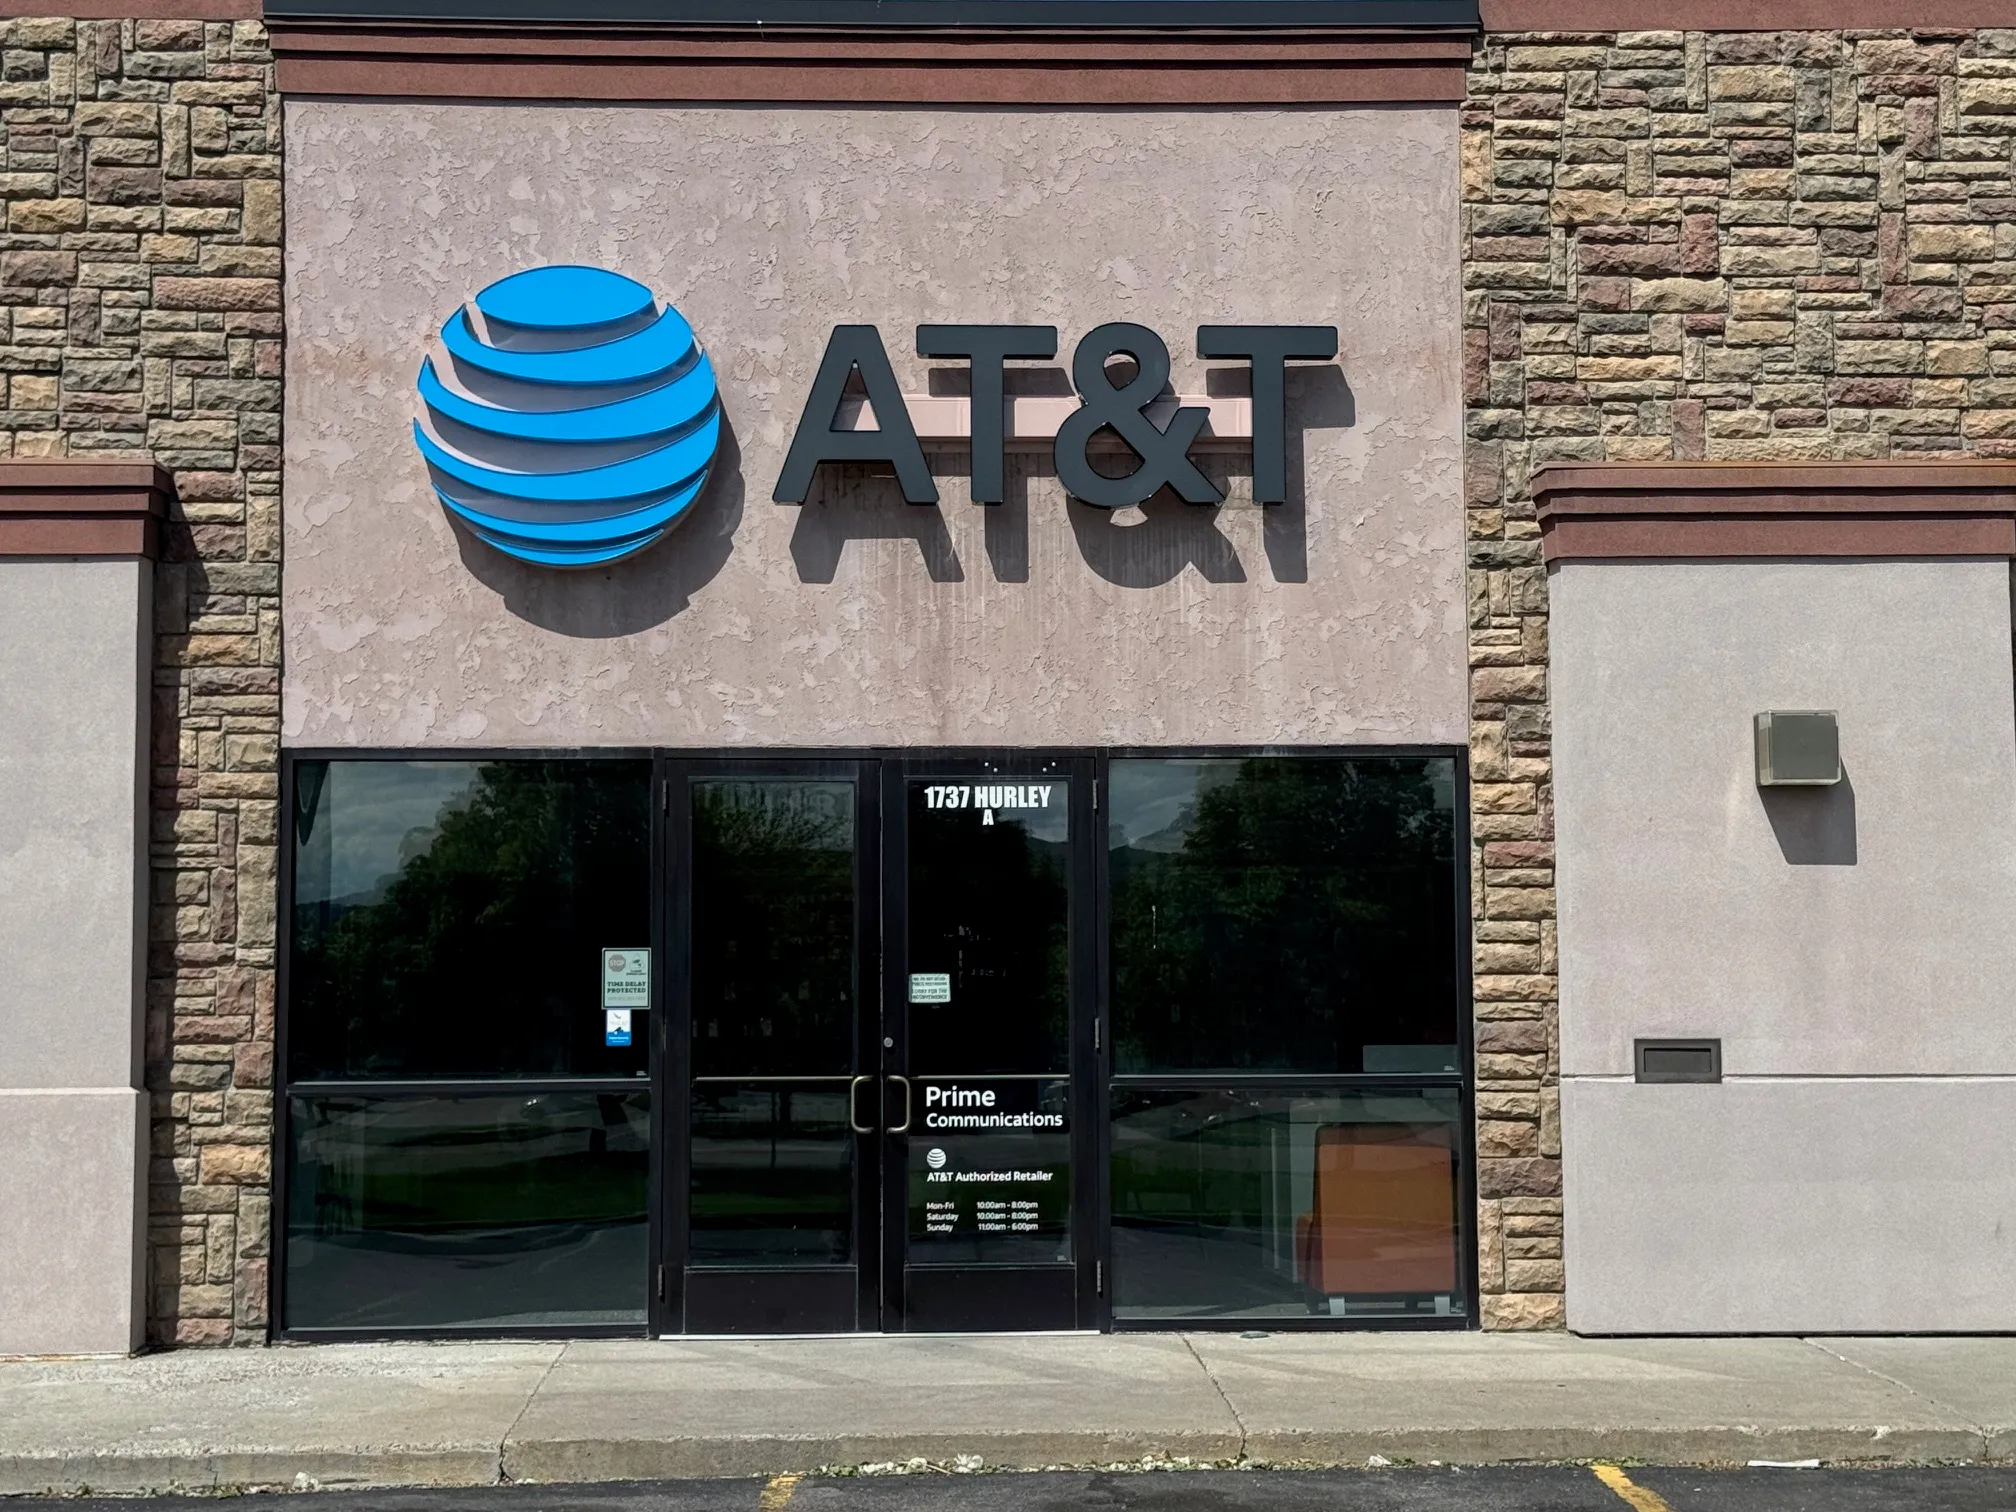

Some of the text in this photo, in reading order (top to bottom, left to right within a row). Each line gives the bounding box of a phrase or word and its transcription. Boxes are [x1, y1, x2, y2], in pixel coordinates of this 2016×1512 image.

[772, 322, 1339, 507] AT&T
[923, 785, 1052, 809] 1737 HURLEY
[982, 808, 995, 826] A
[926, 1085, 996, 1107] Prime
[926, 1111, 1063, 1128] Communications
[926, 1171, 1053, 1182] AT&T Authorized Retailer
[926, 1201, 955, 1210] Mon-Fri
[926, 1212, 959, 1222] Saturday
[926, 1223, 954, 1233] Sunday
